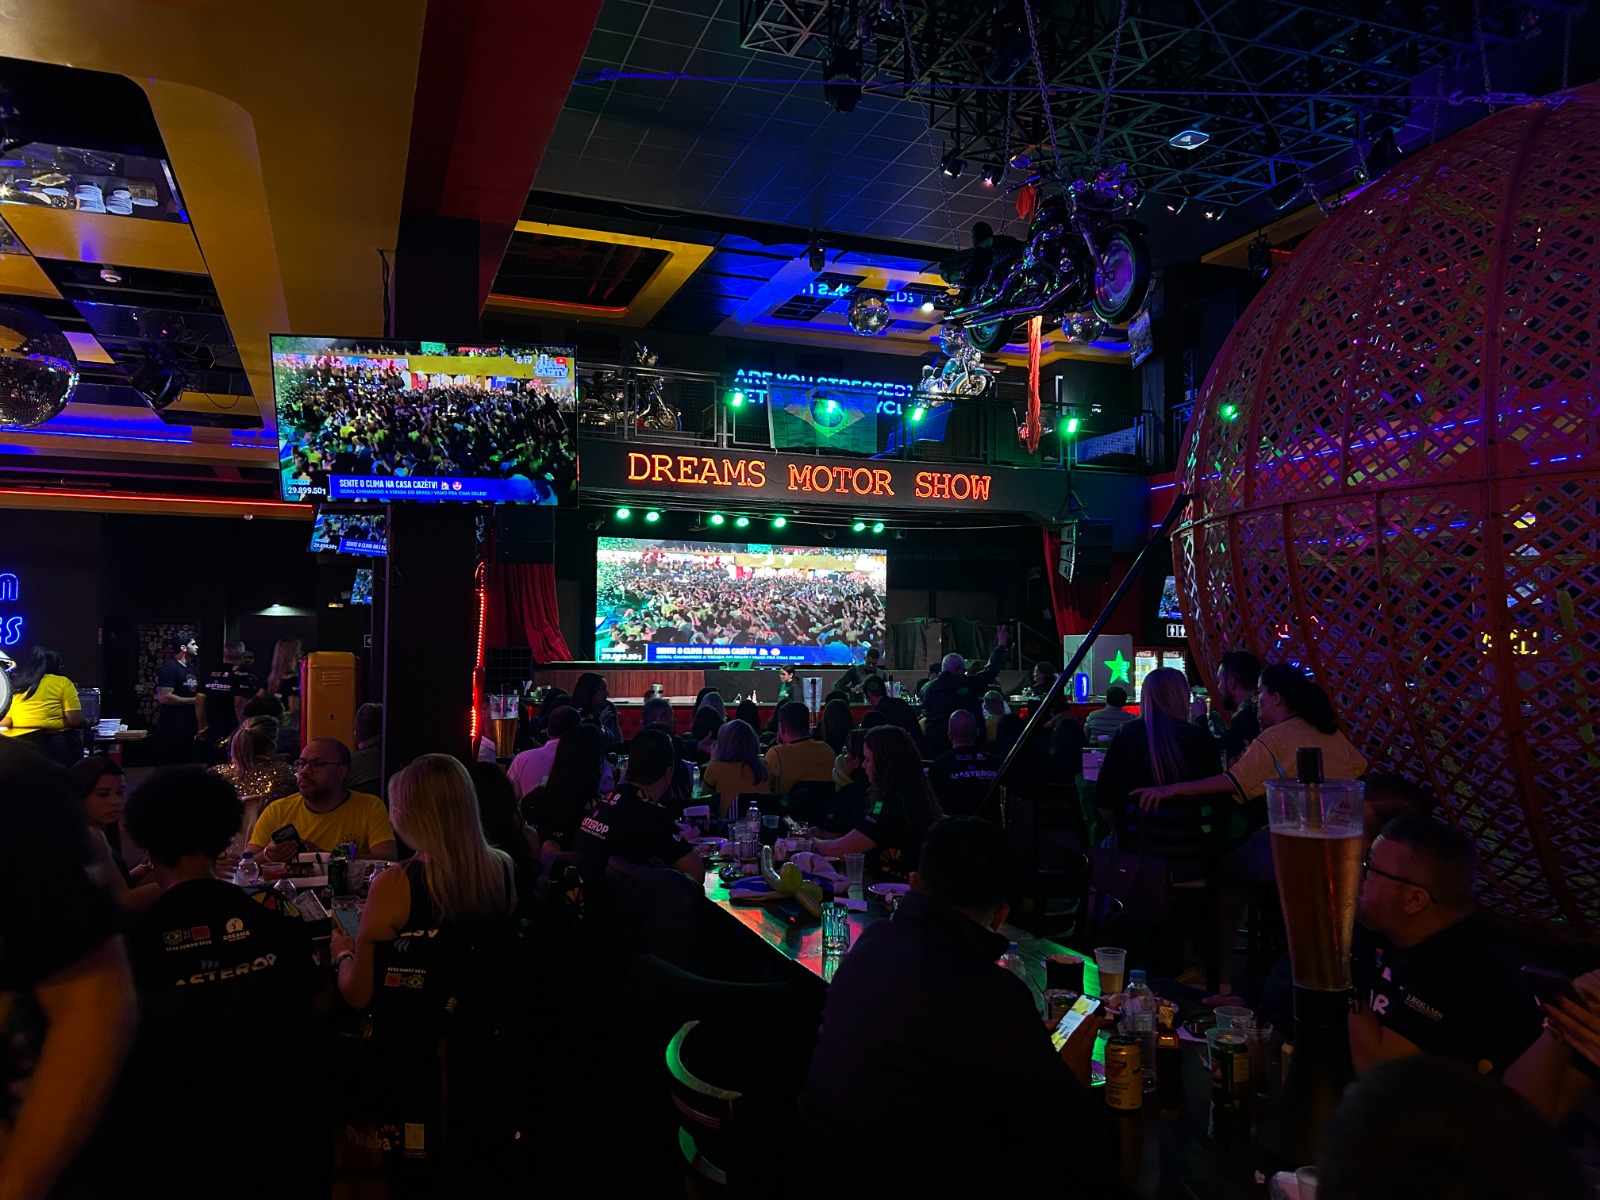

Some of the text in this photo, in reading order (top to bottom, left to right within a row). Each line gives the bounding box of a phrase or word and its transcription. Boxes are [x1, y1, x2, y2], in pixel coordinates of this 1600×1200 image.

[339, 478, 438, 489] SENTE O CLIMA NA CASA CAZÉTV!
[627, 452, 993, 500] DREAMS MOTOR SHOW
